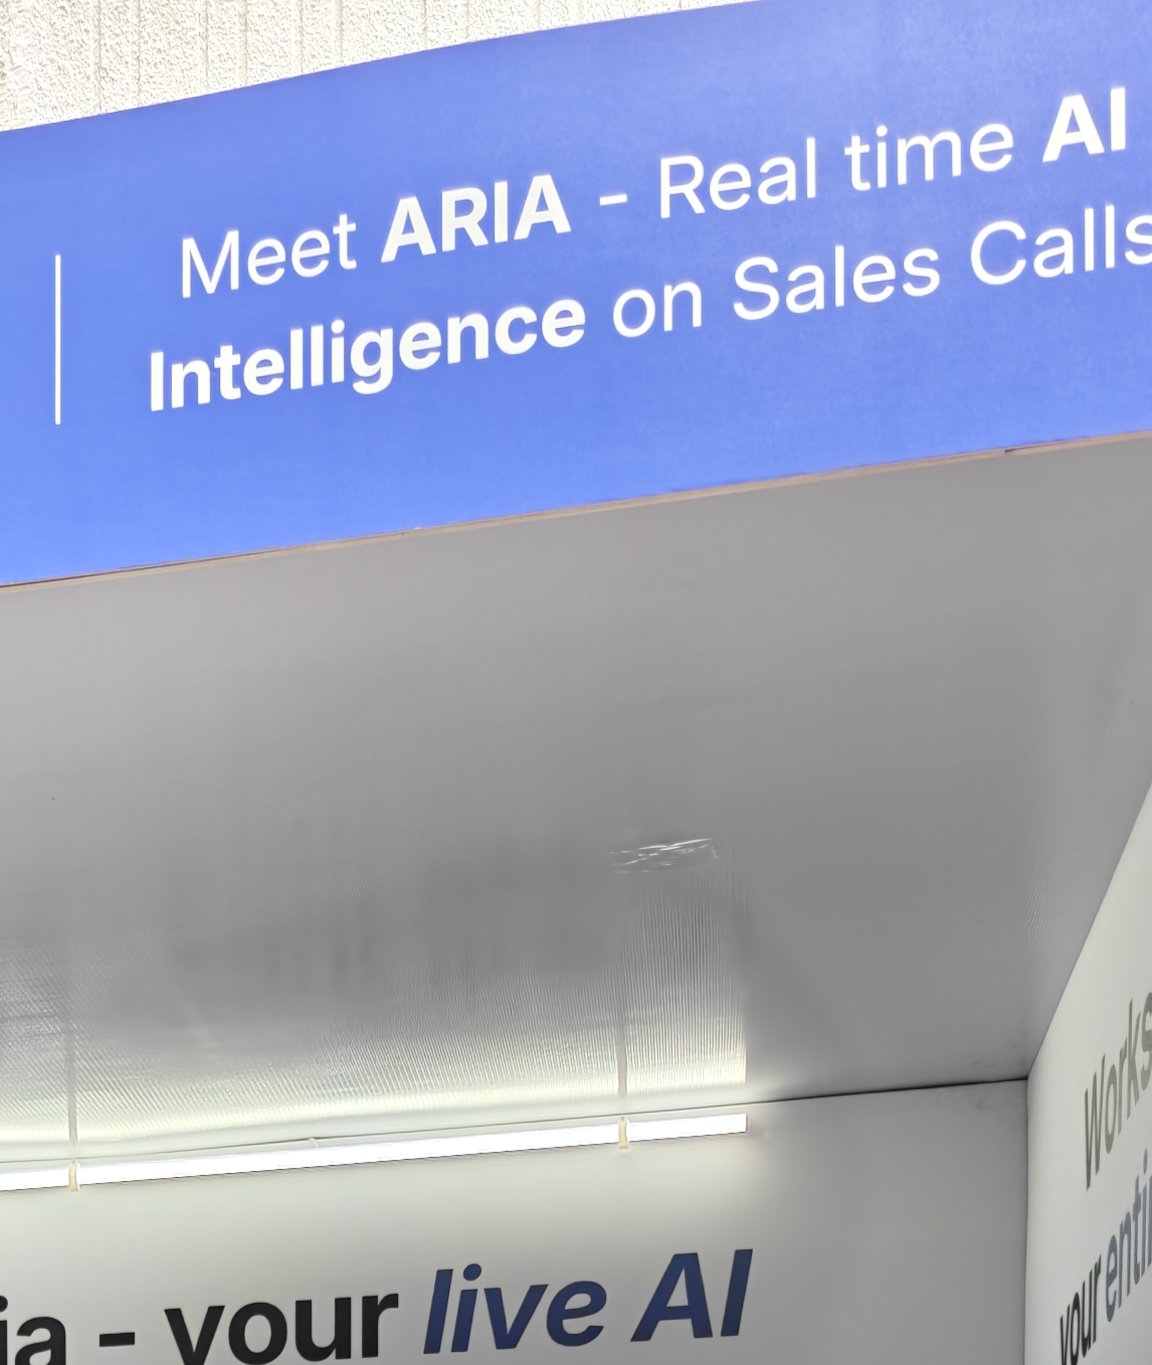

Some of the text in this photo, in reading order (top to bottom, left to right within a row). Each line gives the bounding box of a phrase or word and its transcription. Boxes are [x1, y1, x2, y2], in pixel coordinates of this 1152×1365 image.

[180, 86, 1128, 299] Meet ARIA - Real time AI
[149, 204, 1152, 411] Intelligence on Sales Calls
[1084, 991, 1152, 1191] Works
[99, 1331, 136, 1348] -
[423, 1262, 607, 1355] live
[632, 1248, 754, 1343] AI
